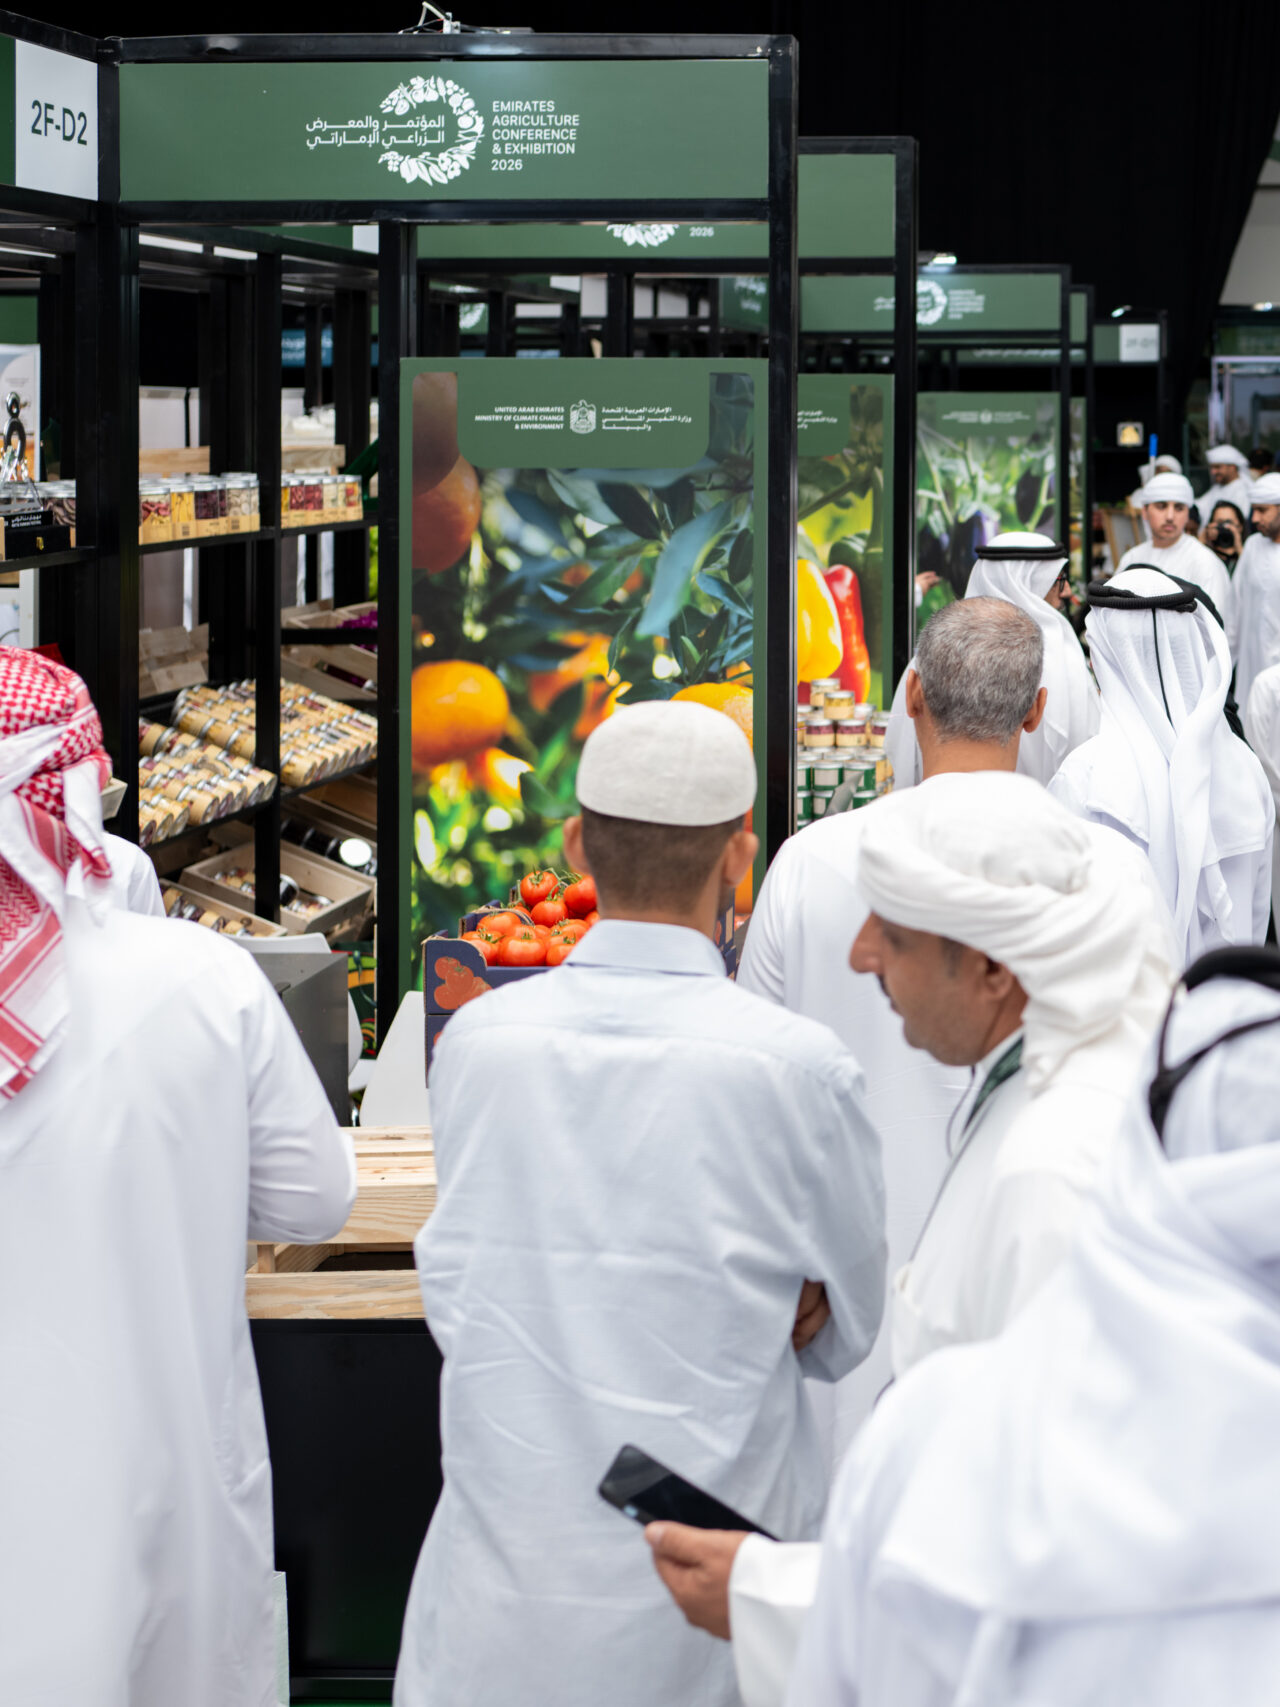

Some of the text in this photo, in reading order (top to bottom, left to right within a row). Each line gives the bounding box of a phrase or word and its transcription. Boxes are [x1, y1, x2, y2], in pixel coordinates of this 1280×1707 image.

[493, 101, 554, 112] EMIRATES
[31, 100, 88, 146] 2F-D2
[306, 116, 444, 132] المؤتمر والمعرض
[492, 115, 579, 126] AGRICULTURE
[306, 131, 444, 149] الزراعي الإماراتي
[492, 129, 576, 140] CONFERENCE
[492, 143, 575, 154] & EXHIBITION
[492, 160, 523, 170] 2026
[690, 227, 714, 237] 2026
